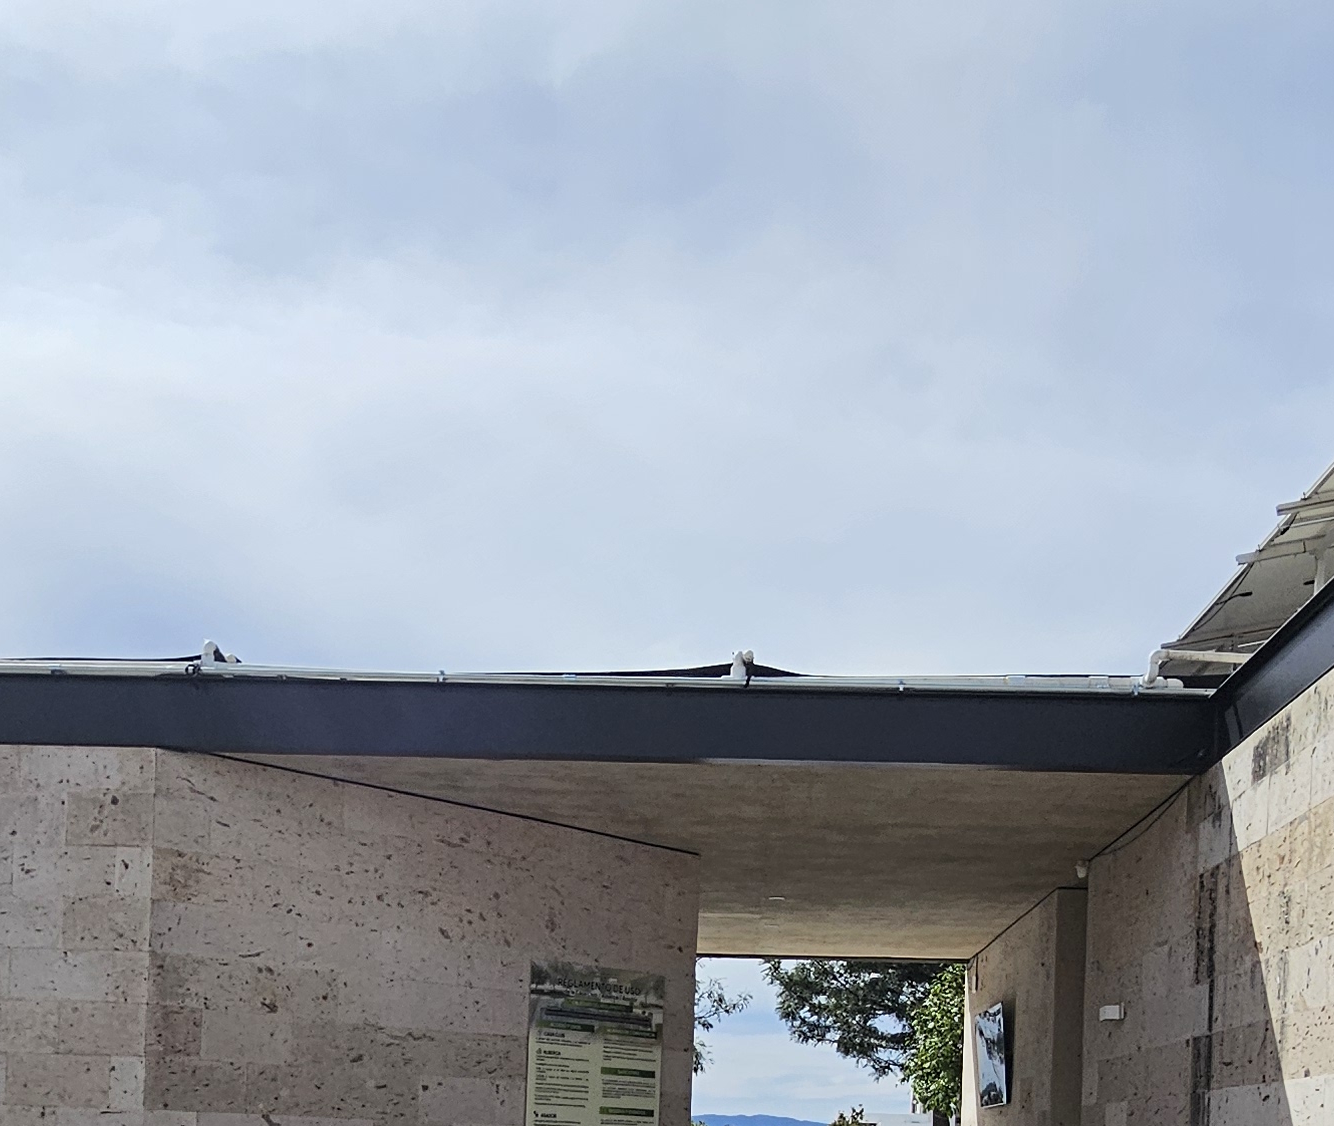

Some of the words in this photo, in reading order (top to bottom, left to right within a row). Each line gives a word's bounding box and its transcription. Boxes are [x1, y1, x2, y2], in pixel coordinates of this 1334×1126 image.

[557, 978, 612, 992] REGLAMENTO
[612, 984, 624, 994] DE
[624, 986, 641, 996] USO
